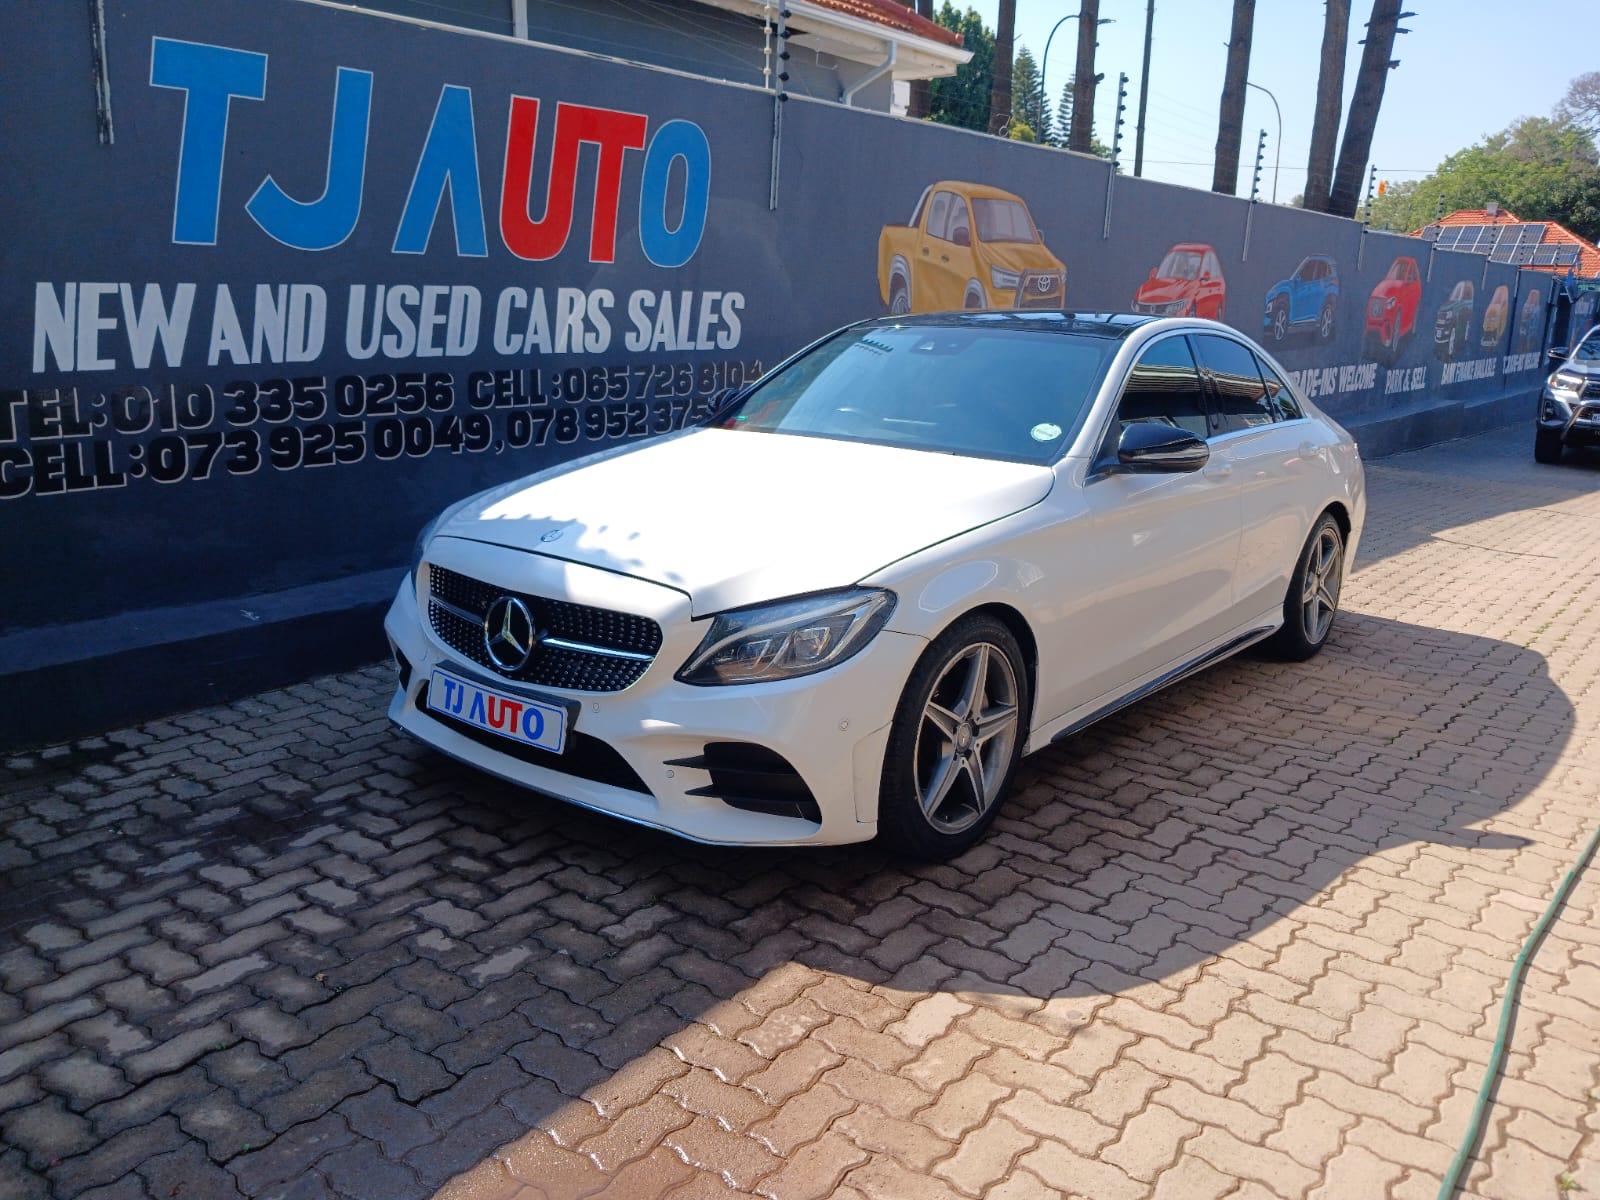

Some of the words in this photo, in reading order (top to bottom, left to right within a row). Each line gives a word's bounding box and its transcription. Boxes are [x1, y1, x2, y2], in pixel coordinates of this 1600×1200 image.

[149, 36, 373, 252] TJ
[391, 83, 712, 268] AUTO
[32, 282, 197, 374] NEW
[207, 284, 327, 366] AND
[346, 285, 480, 360] USED
[493, 287, 614, 355] CARS
[627, 291, 746, 351] SALES
[223, 376, 328, 427] 335
[334, 372, 455, 418] 0256
[1288, 366, 1338, 398] RADE-INS
[1338, 362, 1378, 393] WELCOME
[1410, 366, 1427, 391] SELL
[269, 421, 367, 471] 925
[586, 403, 649, 441] 952
[444, 678, 464, 714] TJ
[469, 691, 544, 740] AUTO
